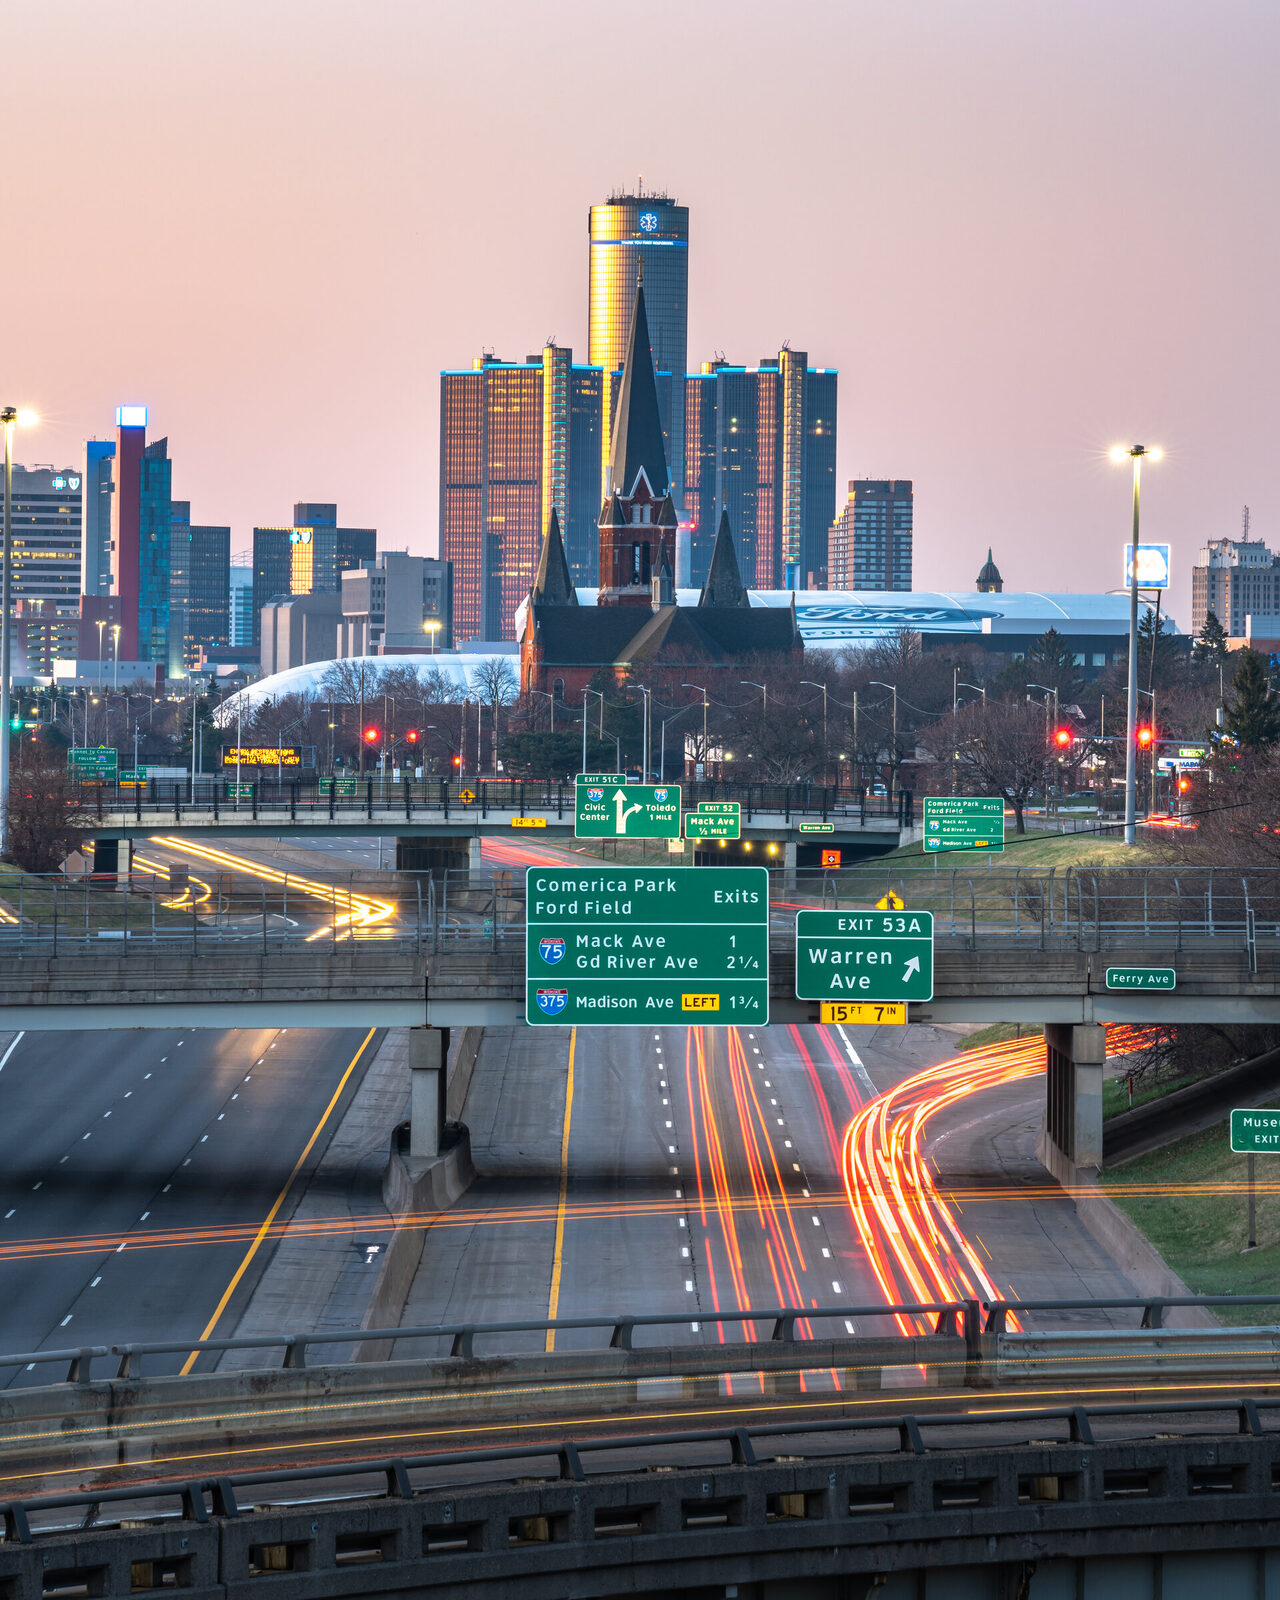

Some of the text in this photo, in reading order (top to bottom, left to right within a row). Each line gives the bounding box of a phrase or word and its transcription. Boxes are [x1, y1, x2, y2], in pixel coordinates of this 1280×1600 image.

[797, 606, 948, 620] Ford
[657, 792, 667, 800] 75
[584, 803, 606, 811] Civic
[645, 804, 676, 812] Toledo
[579, 813, 610, 821] Center
[690, 817, 735, 825] Mack Ave
[536, 878, 677, 892] Comerica Park
[714, 890, 759, 903] Exits
[536, 900, 632, 914] Ford Field
[838, 917, 921, 933] EXIT 53A
[576, 934, 736, 948] Mack Ave 1
[541, 945, 563, 959] 75
[808, 948, 892, 965] Warren
[576, 955, 600, 969] Gd
[607, 955, 656, 969] River
[664, 956, 698, 969] Ave
[829, 973, 871, 989] Ave
[1112, 974, 1169, 985] Ferry Ave
[540, 995, 565, 1007] 375
[576, 995, 637, 1008] Madison
[645, 996, 674, 1008] Ave
[684, 998, 717, 1008] LEFT
[831, 1006, 896, 1022] 15 FT 7 IN
[1254, 1134, 1279, 1144] EXIT
